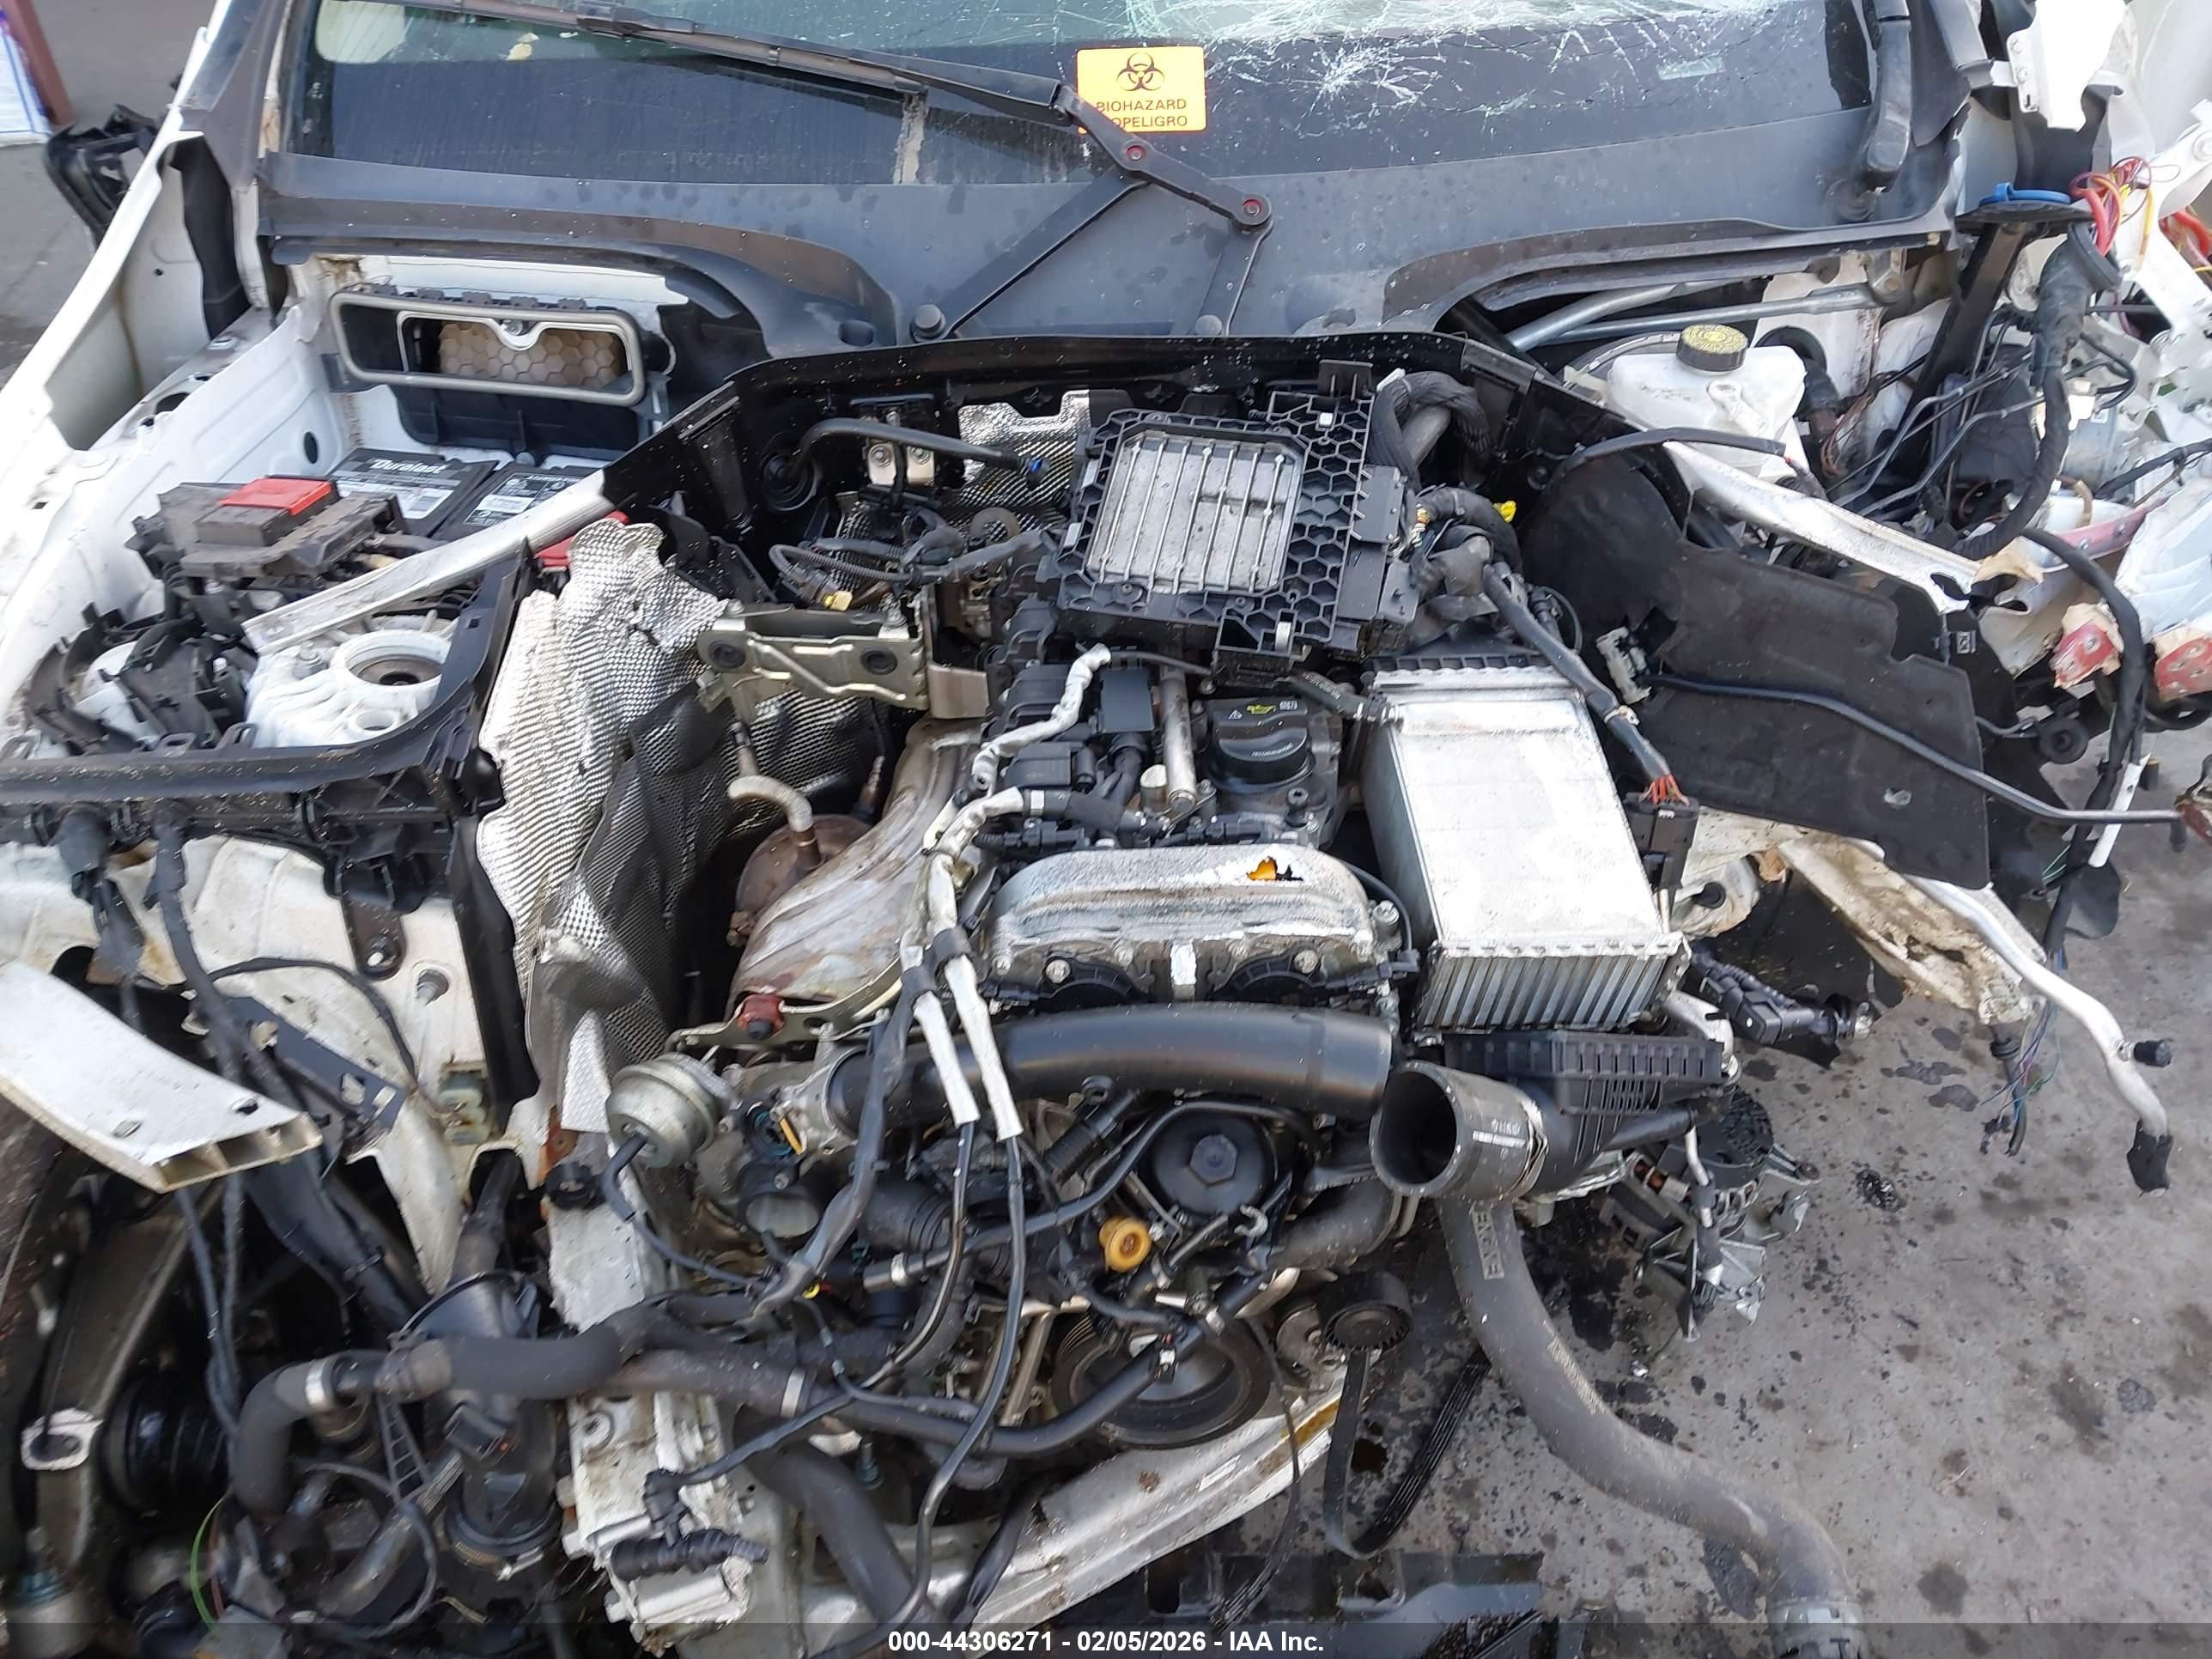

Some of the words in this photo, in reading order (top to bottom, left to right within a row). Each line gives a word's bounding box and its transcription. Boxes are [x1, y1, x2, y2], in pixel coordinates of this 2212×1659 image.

[1097, 98, 1187, 112] BIOHAZARD
[1112, 115, 1188, 128] OPELIGRO
[369, 459, 447, 473] Duralast
